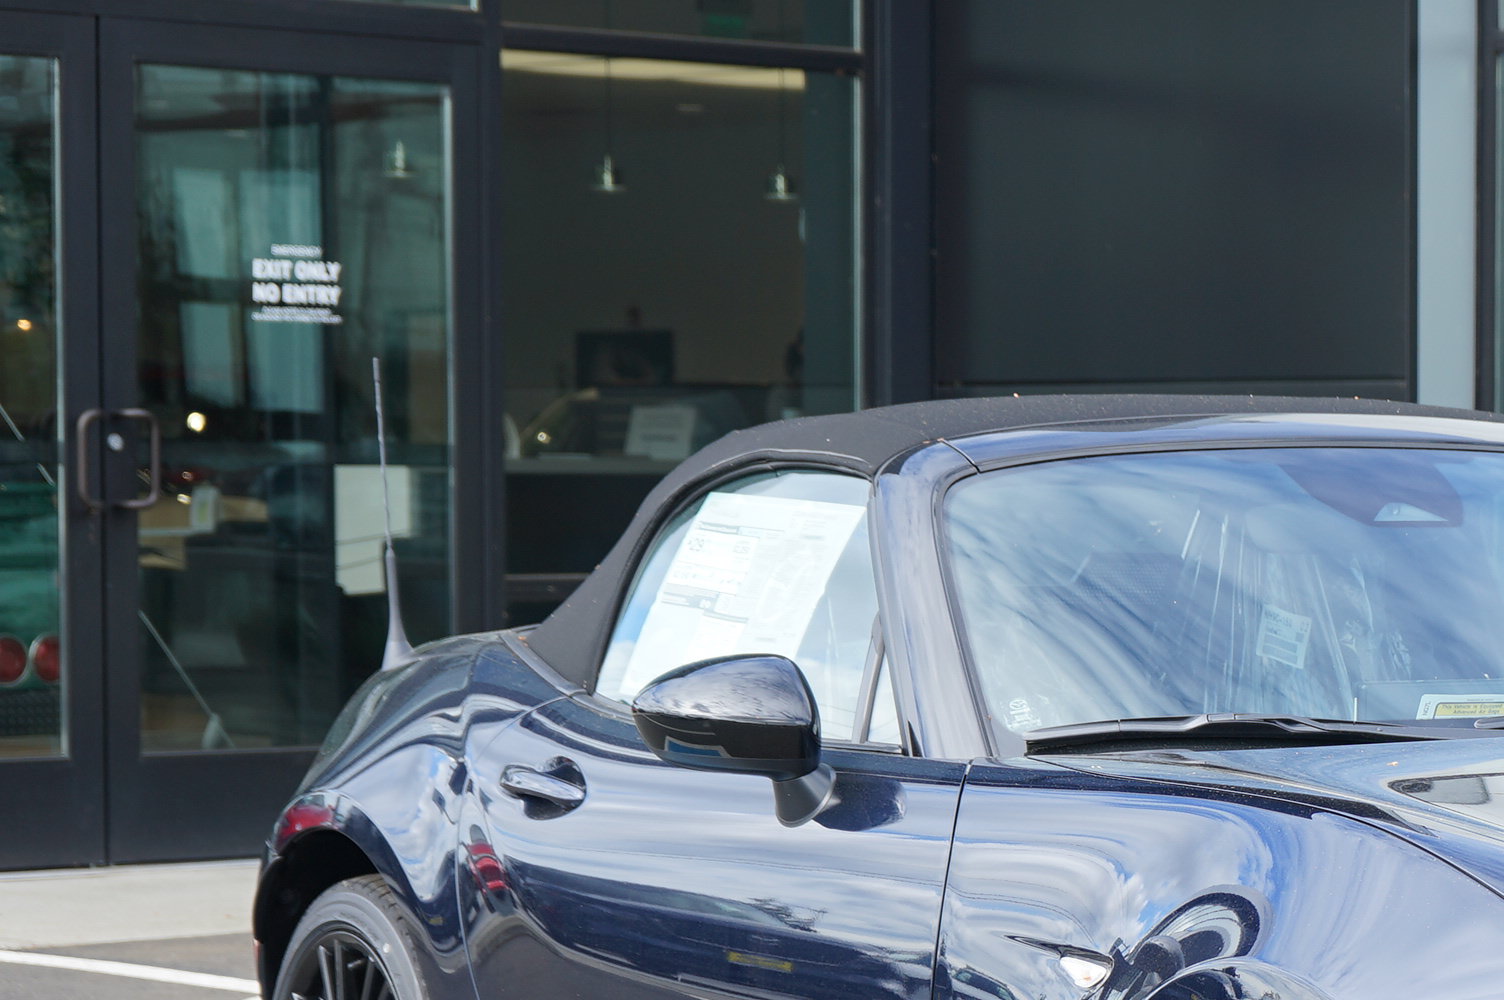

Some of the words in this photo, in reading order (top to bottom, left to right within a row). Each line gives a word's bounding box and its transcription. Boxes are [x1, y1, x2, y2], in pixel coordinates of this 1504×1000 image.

[252, 258, 292, 280] EXIT
[294, 260, 341, 282] ONLY
[252, 282, 281, 304] NO
[282, 283, 341, 305] ENTRY
